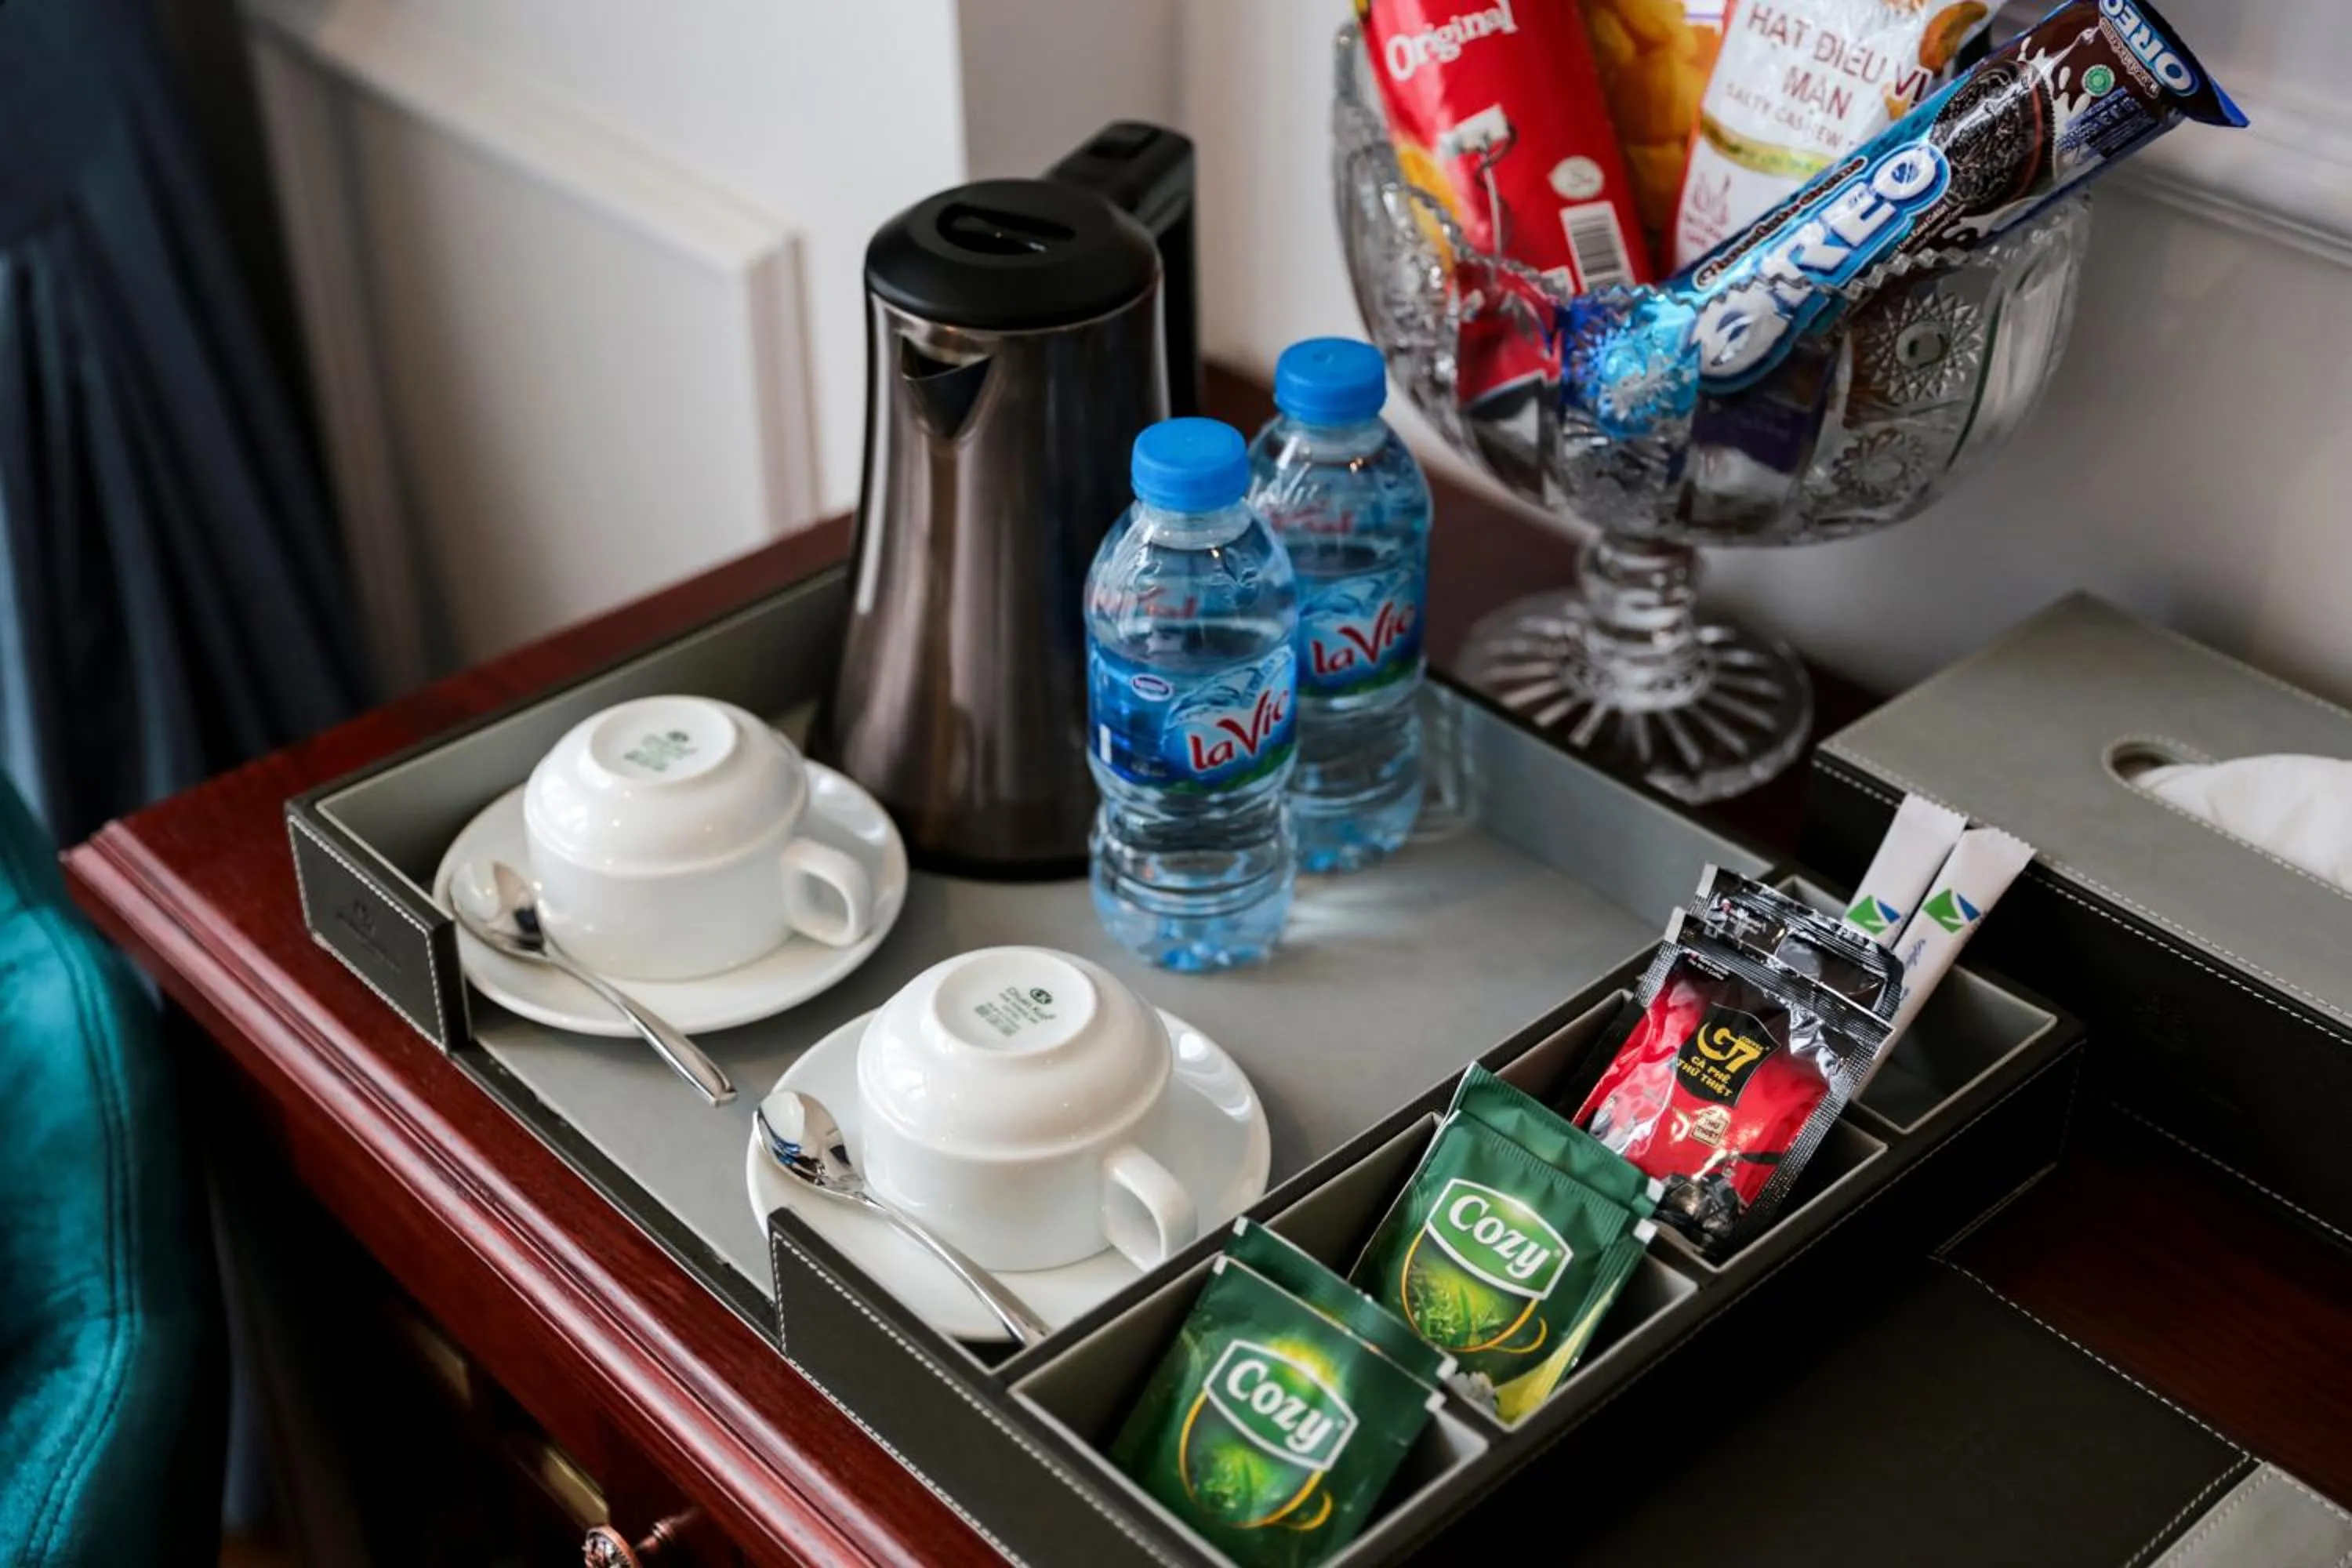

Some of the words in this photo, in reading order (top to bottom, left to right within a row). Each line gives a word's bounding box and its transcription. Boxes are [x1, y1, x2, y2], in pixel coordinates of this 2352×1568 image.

[1385, 0, 1519, 82] Original
[1775, 106, 1843, 149] CASEW
[1691, 146, 1936, 379] OREO
[1697, 1022, 1762, 1074] G7
[1448, 1194, 1551, 1279] Cozy
[1226, 1359, 1334, 1454] Cozy
